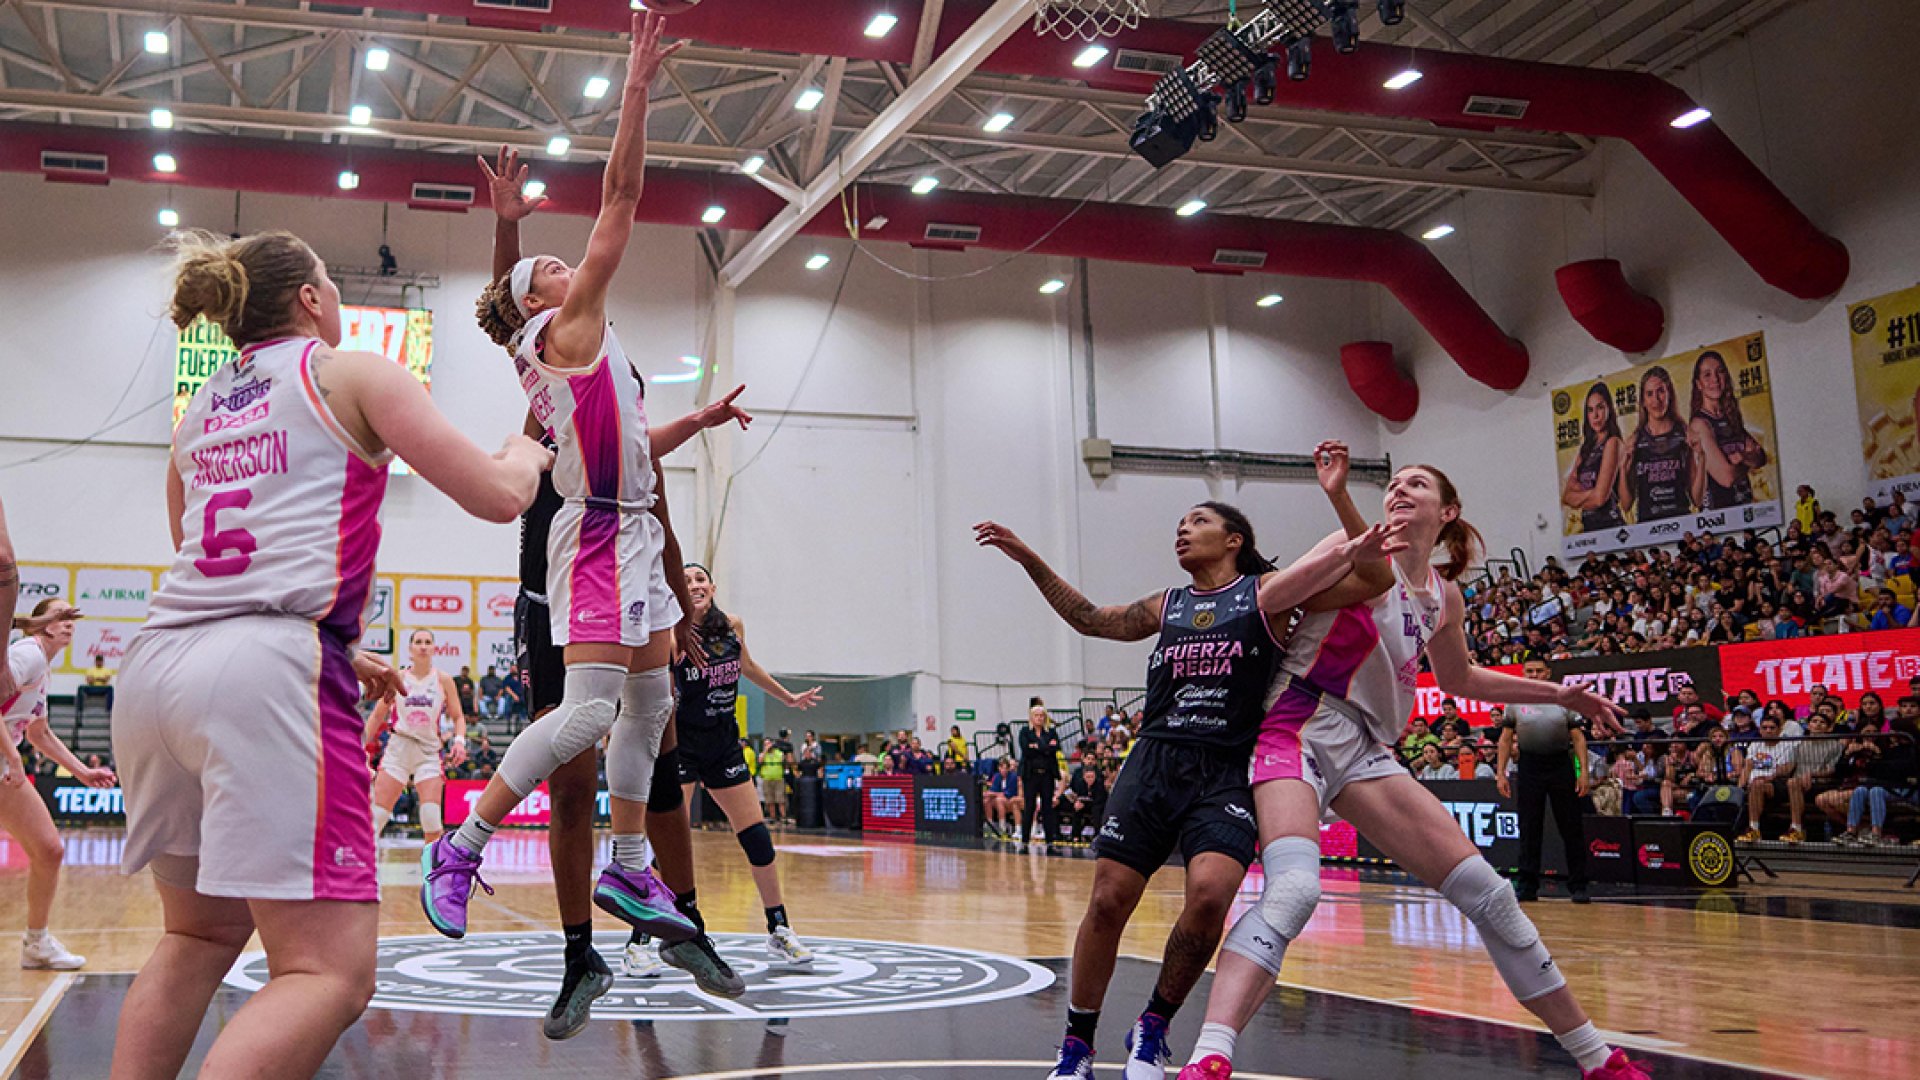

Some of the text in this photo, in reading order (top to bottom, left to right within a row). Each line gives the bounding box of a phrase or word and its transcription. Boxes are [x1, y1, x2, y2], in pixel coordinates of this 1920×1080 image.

[178, 347, 239, 377] FUERZ
[193, 488, 258, 578] 6
[1697, 512, 1725, 529] Doal
[19, 583, 60, 596] TRO
[1164, 640, 1244, 664] FUERZA
[1172, 658, 1233, 680] REGIA
[1754, 650, 1895, 695] TECATE
[54, 786, 125, 814] TECAT
